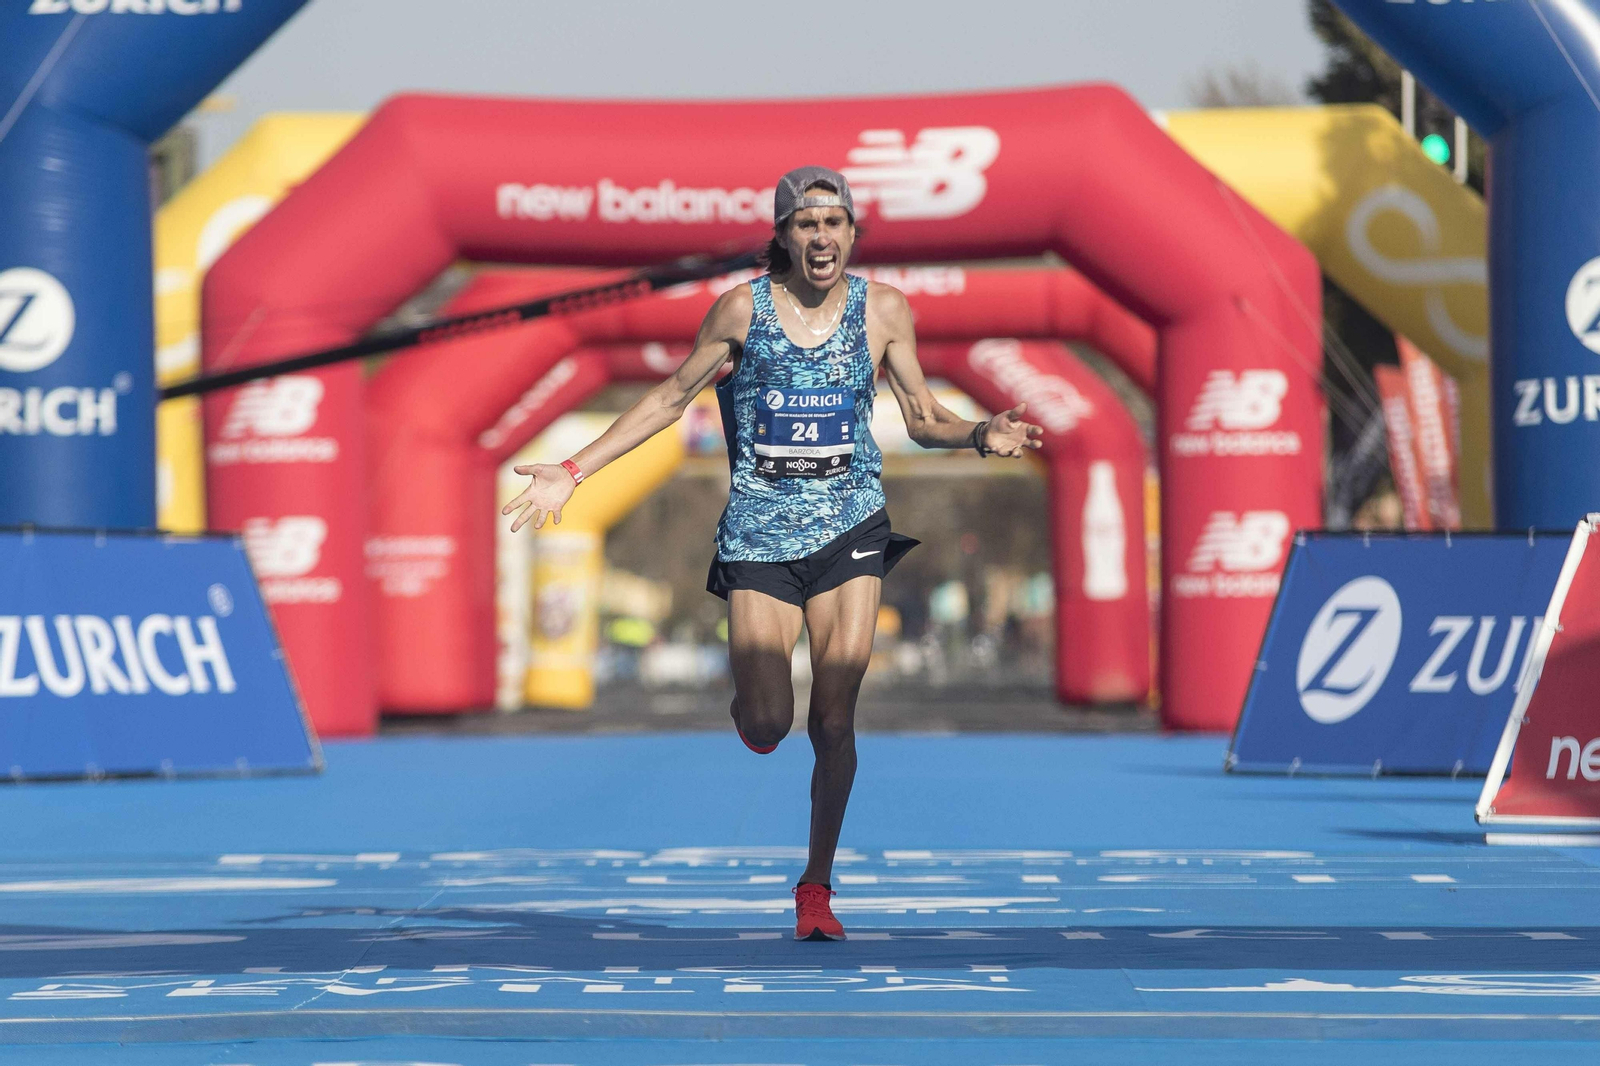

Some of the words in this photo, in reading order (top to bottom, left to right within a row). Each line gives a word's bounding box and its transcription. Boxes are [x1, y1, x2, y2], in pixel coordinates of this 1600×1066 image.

[497, 183, 594, 221] new
[219, 374, 325, 438] NB
[787, 394, 843, 408] ZURICH
[1185, 368, 1288, 431] NB
[791, 422, 819, 442] 24
[825, 466, 847, 476] ZURICH
[1187, 510, 1290, 572] NB
[0, 613, 237, 699] ZURICH
[1408, 615, 1545, 695] ZU
[345, 929, 1584, 942] ZURICH
[42, 964, 1010, 979] ZURICH
[8, 983, 1034, 1000] SEVILLA
